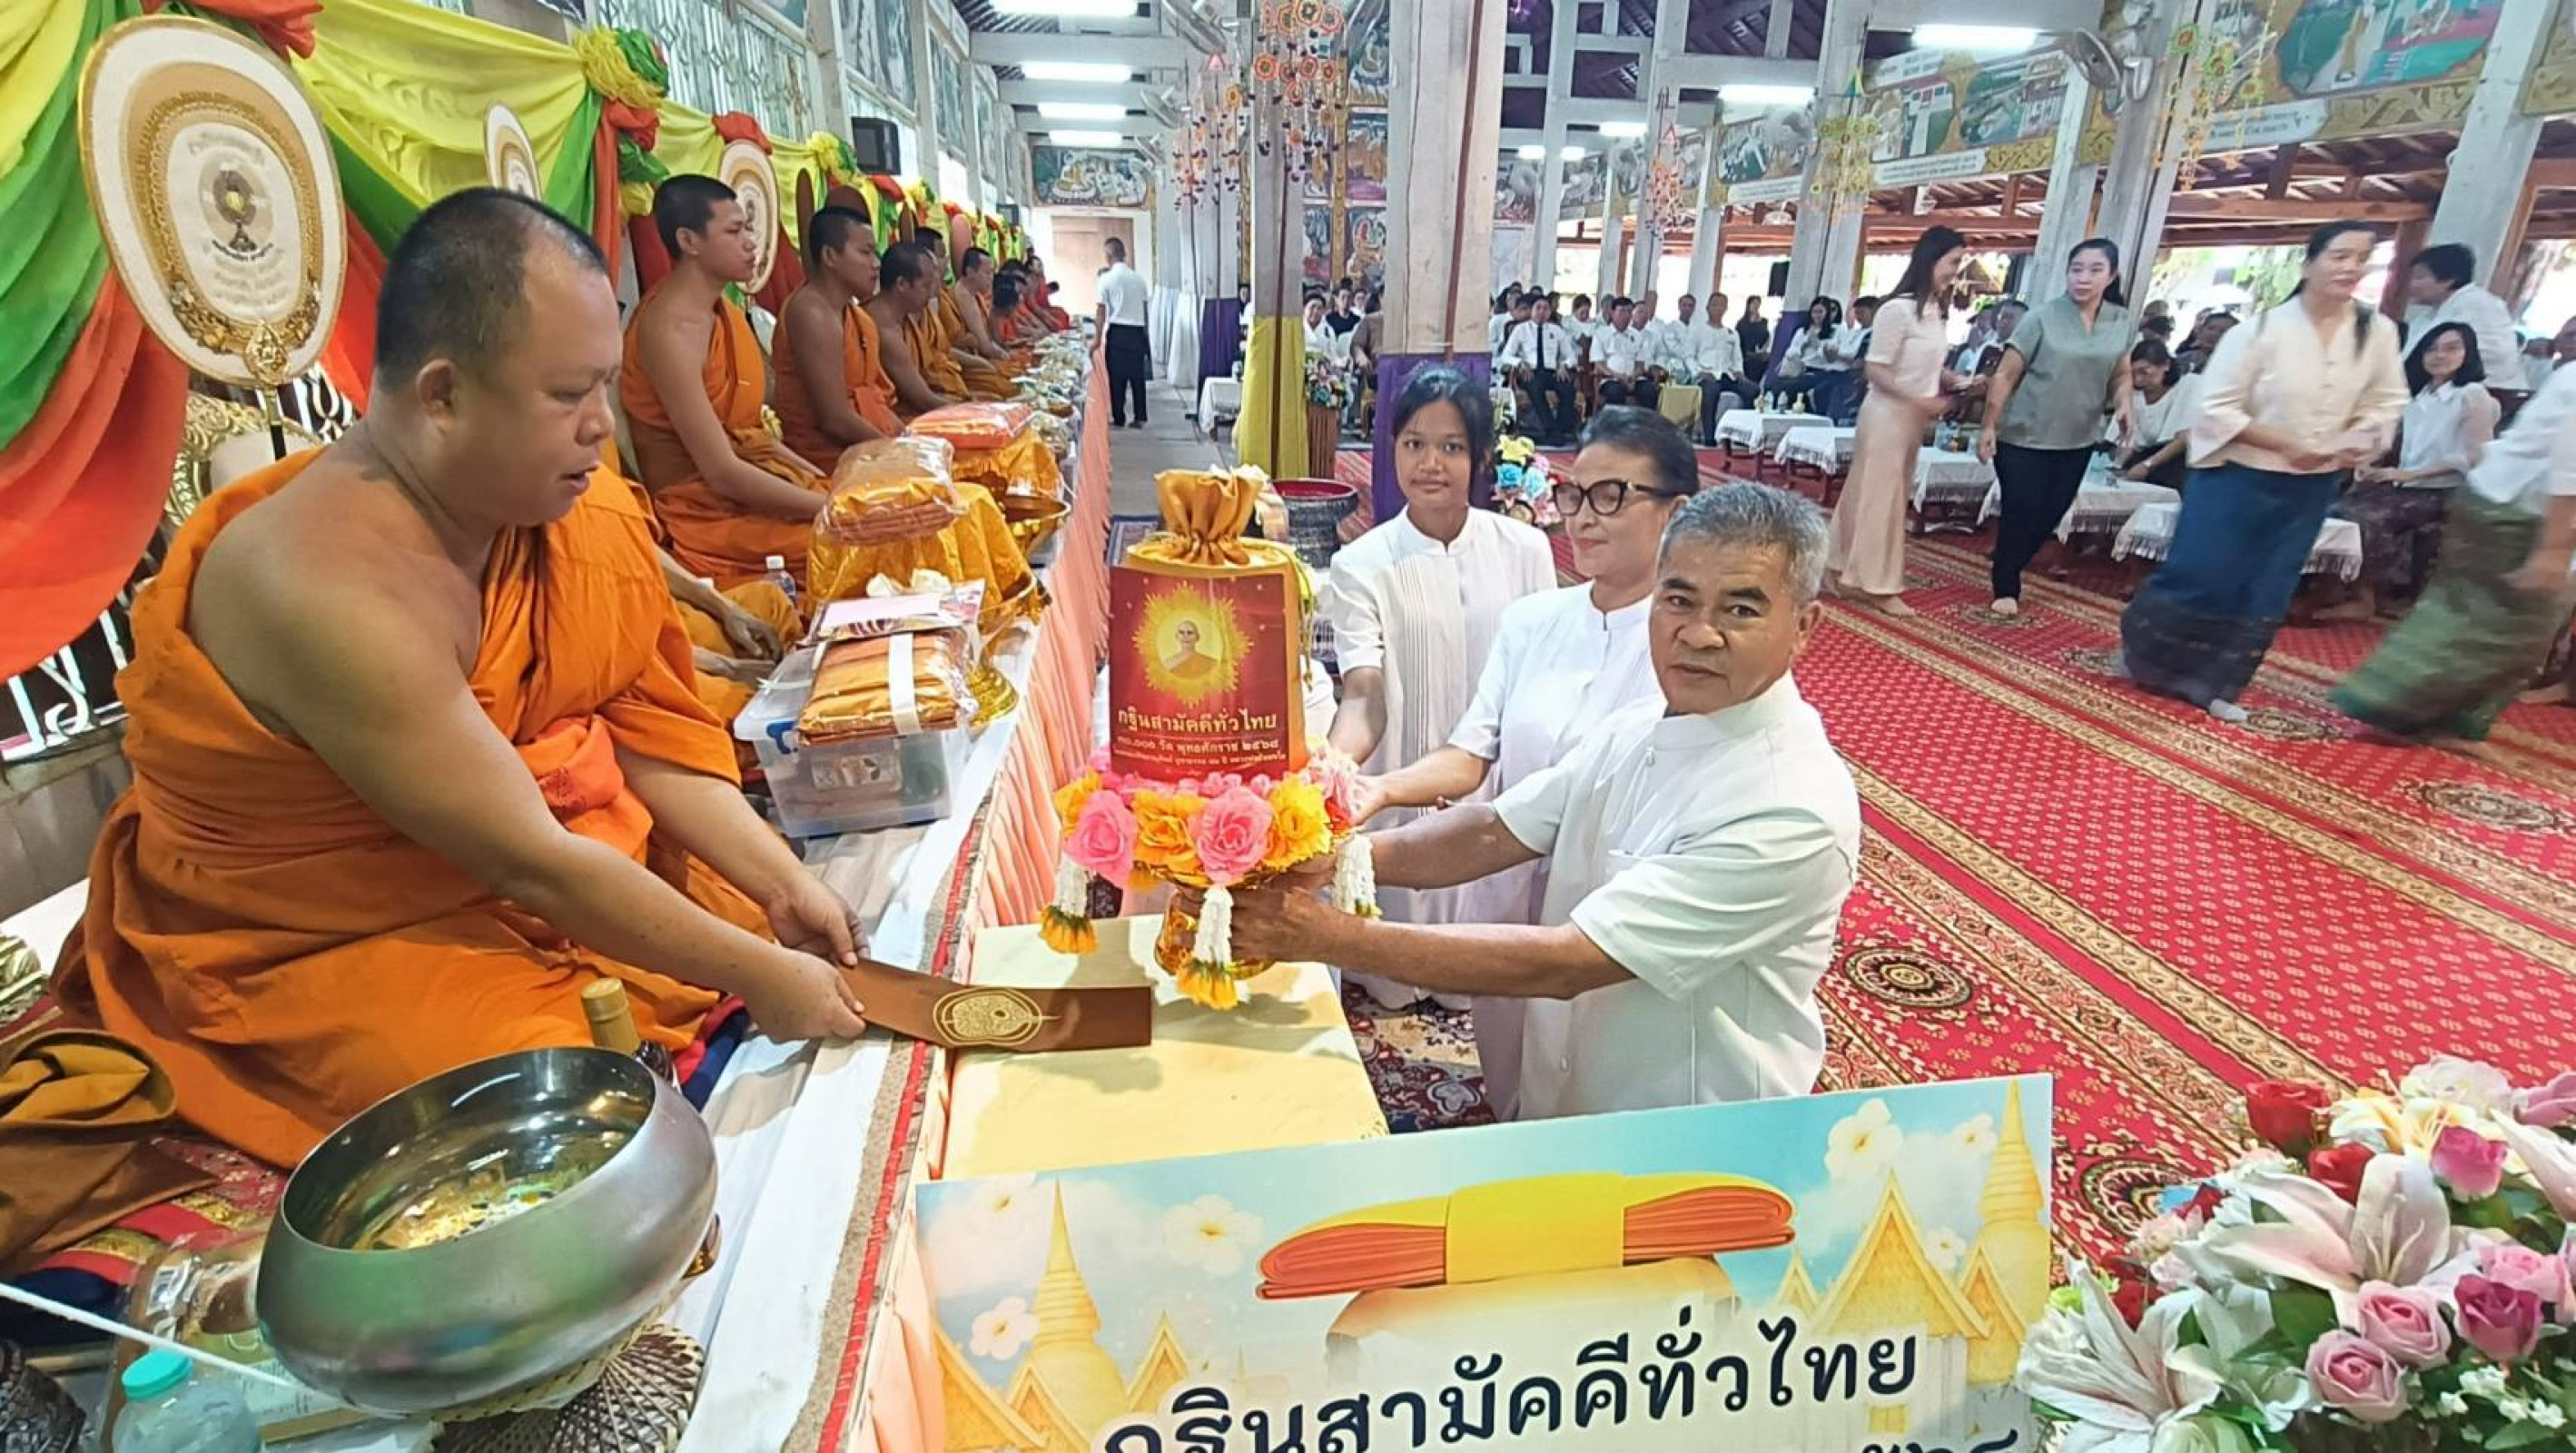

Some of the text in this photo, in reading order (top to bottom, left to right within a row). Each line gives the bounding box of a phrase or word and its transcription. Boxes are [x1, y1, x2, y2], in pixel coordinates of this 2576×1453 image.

[1118, 705, 1278, 733] กฐินสามัคคีทั่วไทย
